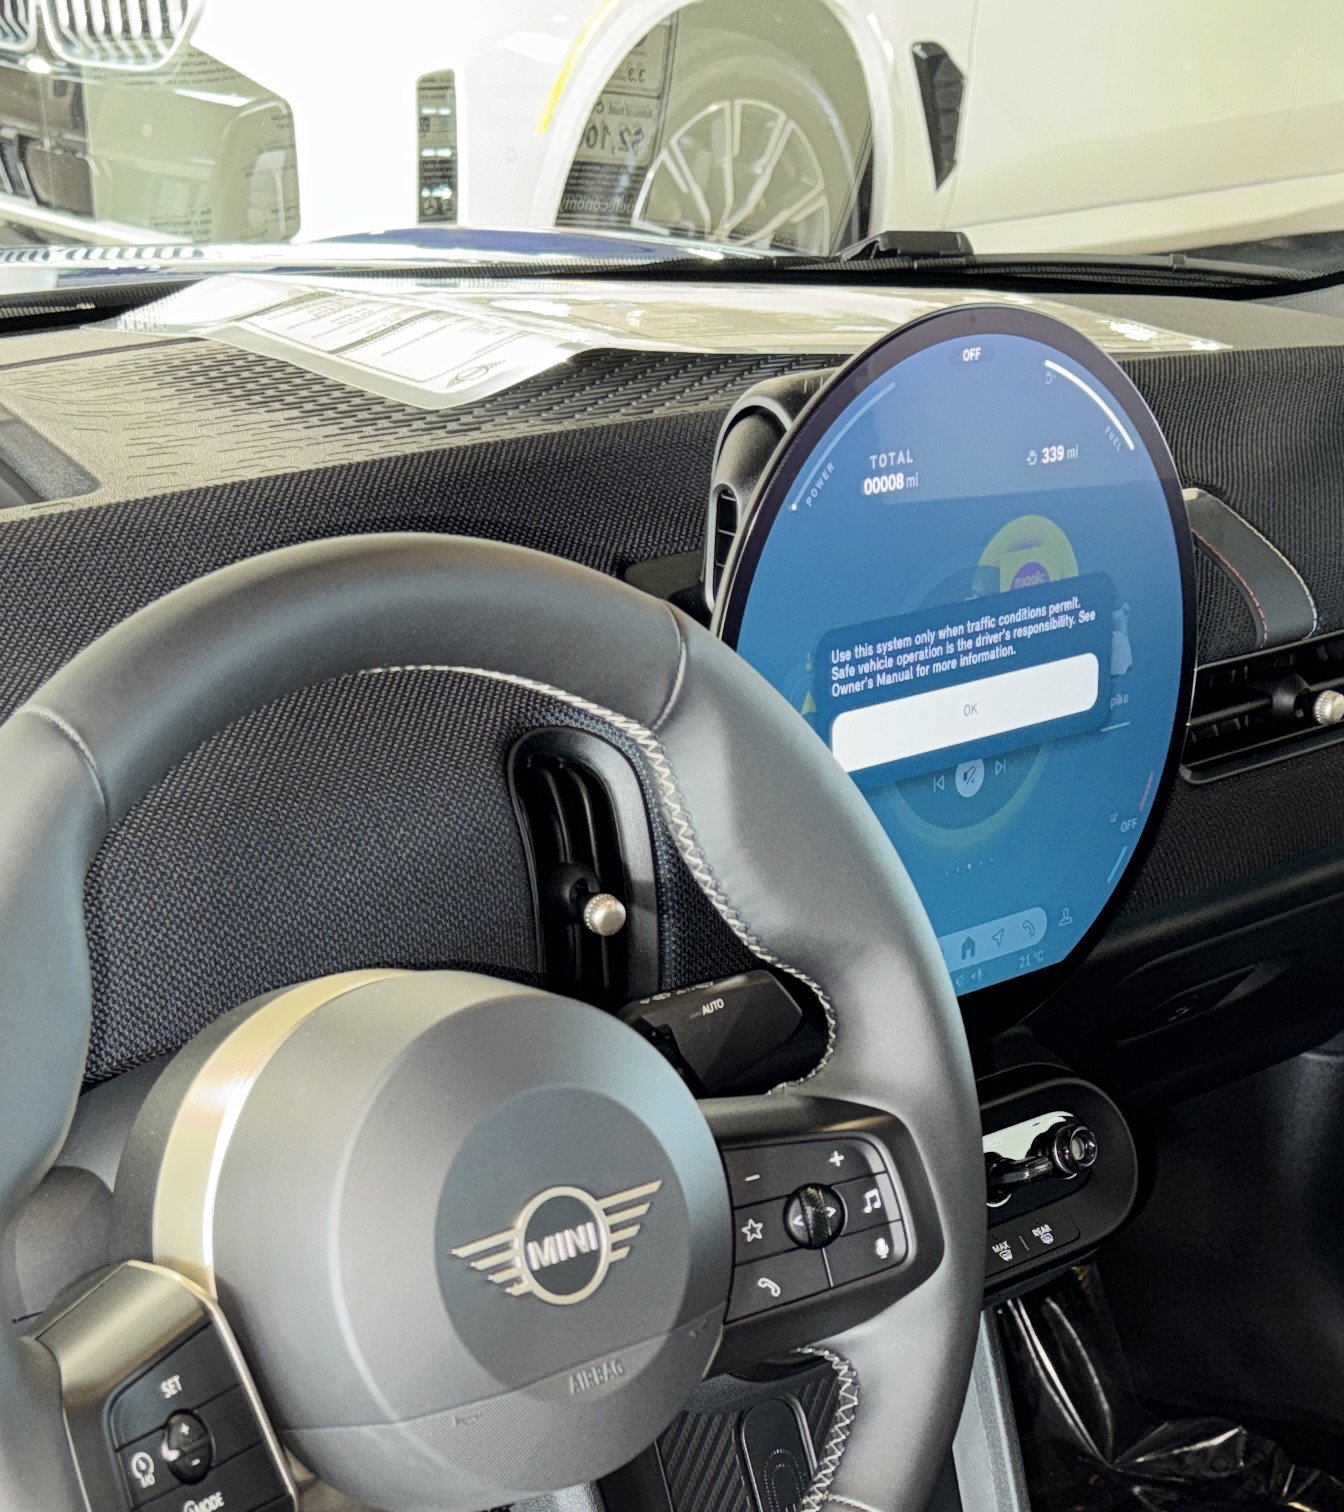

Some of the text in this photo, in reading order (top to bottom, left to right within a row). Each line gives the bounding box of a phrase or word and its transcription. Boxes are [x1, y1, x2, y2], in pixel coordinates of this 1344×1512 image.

[962, 347, 982, 362] OFF
[1104, 426, 1123, 452] FUEL
[869, 449, 914, 470] TOTAL
[1041, 445, 1079, 464] 339 mi
[806, 462, 836, 508] POWER
[863, 472, 919, 496] 00008 mi
[831, 595, 1081, 664] Use this system only when traffic conditions permit.
[831, 609, 1096, 681] Safe vehicle operation is the driver's responsibility. See
[831, 644, 1016, 698] Owner's Manual for more information.
[963, 703, 978, 717] OK
[1110, 694, 1129, 709] pike
[1121, 818, 1138, 832] OFF
[1019, 955, 1031, 969] 21
[702, 999, 725, 1016] AUTO
[1031, 1224, 1052, 1237] REAR
[526, 1221, 600, 1271] MINI
[992, 1241, 1010, 1253] MAX
[160, 1374, 183, 1399] SET
[568, 1358, 626, 1395] AIRBAG
